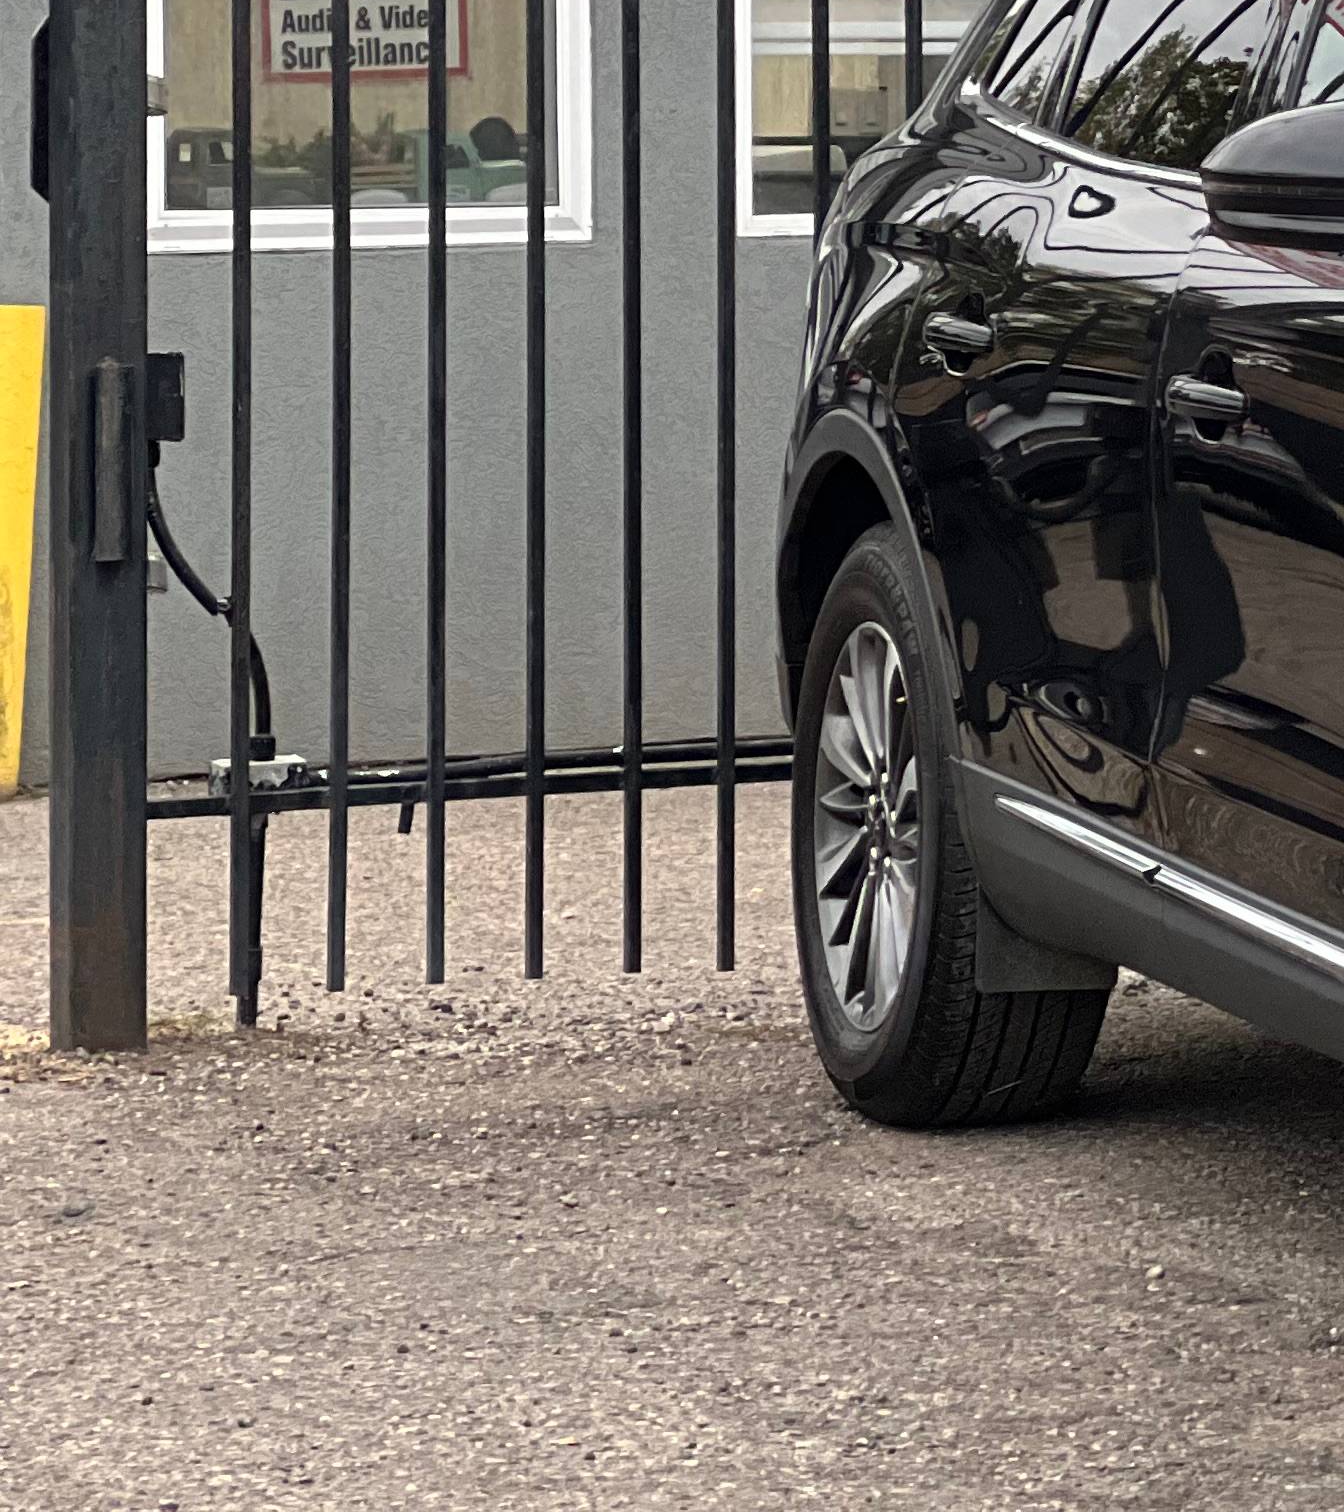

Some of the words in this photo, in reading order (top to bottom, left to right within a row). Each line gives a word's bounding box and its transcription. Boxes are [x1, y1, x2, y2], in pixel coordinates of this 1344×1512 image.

[281, 8, 335, 34] Audi
[355, 6, 372, 31] &
[380, 4, 430, 30] Vide
[281, 37, 431, 70] Sureillanc
